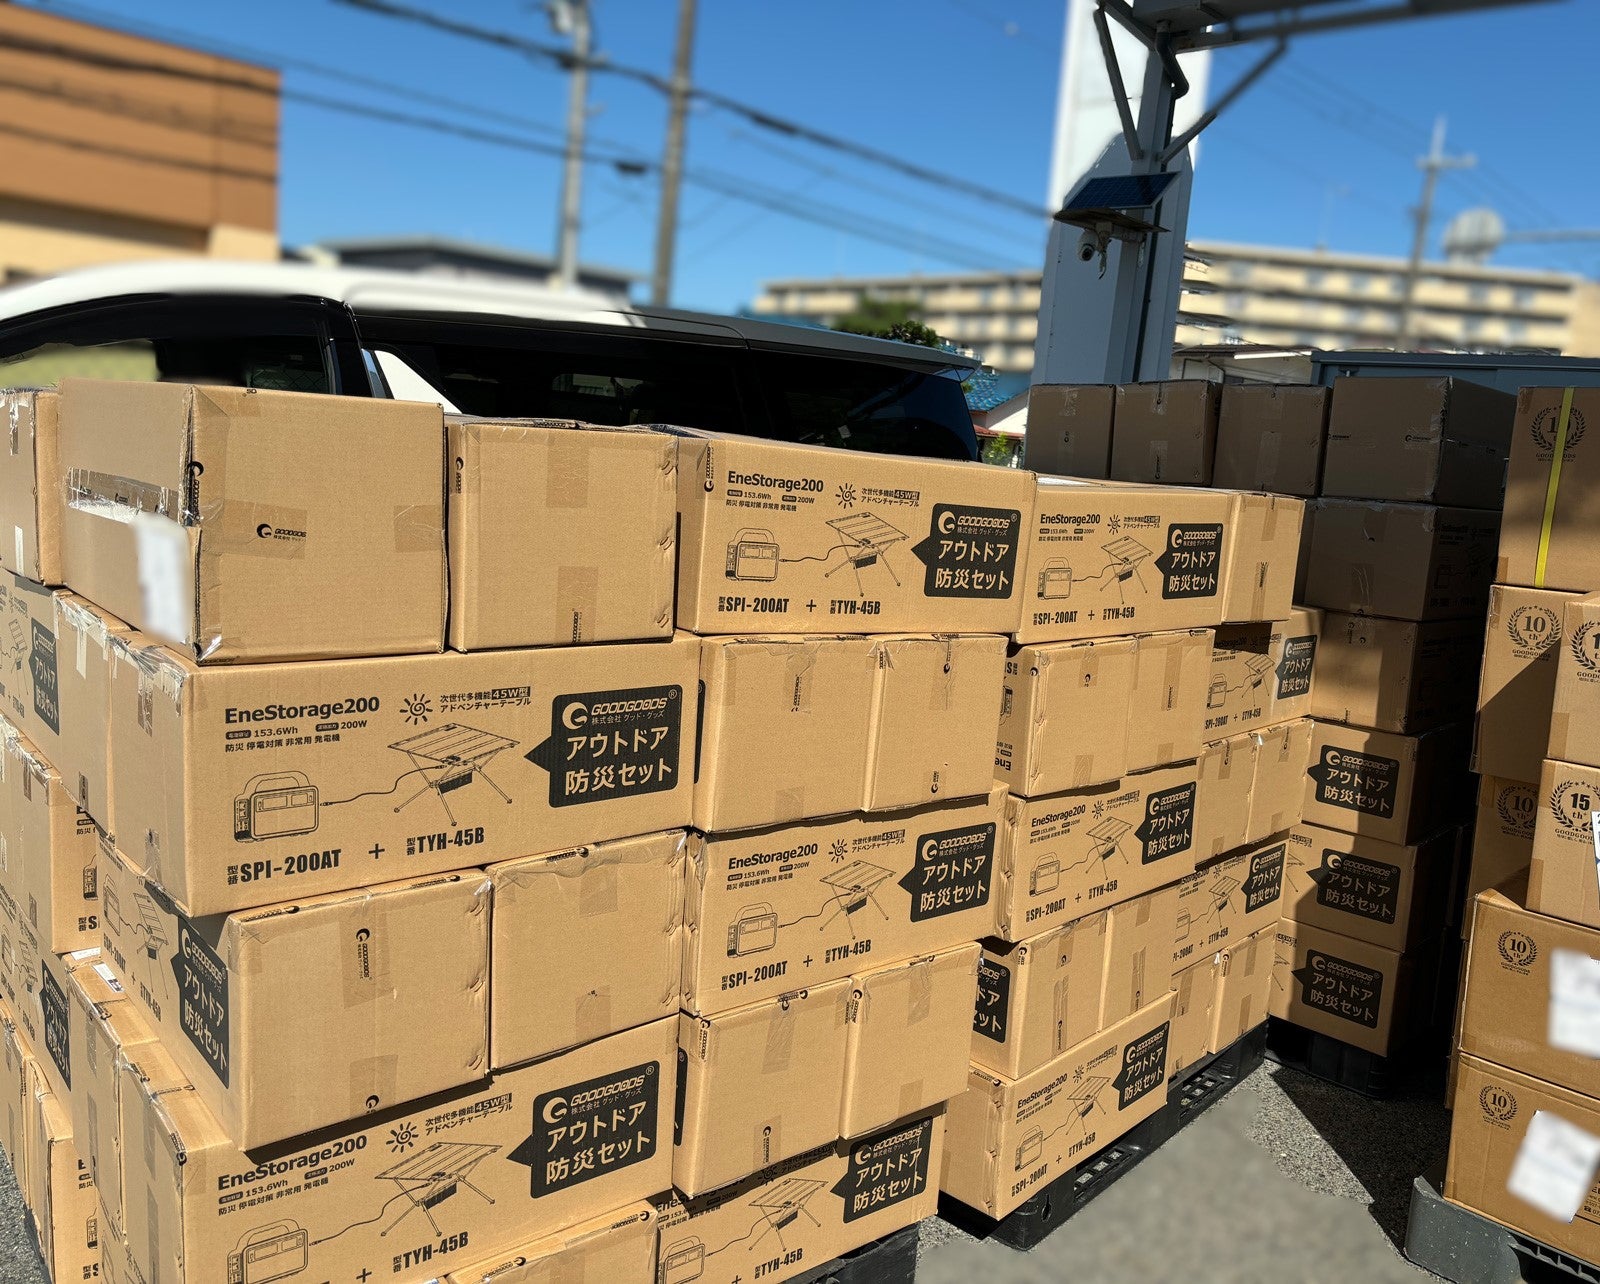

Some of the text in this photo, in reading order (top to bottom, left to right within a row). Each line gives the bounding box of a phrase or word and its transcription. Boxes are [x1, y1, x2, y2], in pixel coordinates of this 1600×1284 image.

[728, 470, 824, 492] EneStorage200
[743, 491, 772, 500] 153.6Wh
[797, 496, 815, 504] 200W
[957, 515, 1010, 529] GOODGOODS
[1040, 513, 1100, 525] EneStorage200
[1184, 531, 1217, 540] GOODGOODS
[938, 540, 1009, 563] アウトドア
[1171, 551, 1216, 569] アウトドア
[935, 567, 1009, 590] 防災セット
[1168, 575, 1215, 592] 防災セット
[726, 596, 789, 613] SPI-200AT
[837, 600, 880, 615] TYH-45B
[1038, 610, 1078, 625] SPI-200AT
[1107, 606, 1135, 619] TYH-45B
[1522, 615, 1546, 633] 10
[1529, 631, 1539, 641] th
[1284, 657, 1311, 674] アウトドア
[440, 686, 531, 703] 次世代多機能45W型
[1281, 676, 1309, 694] 防災セット
[225, 696, 380, 723] EneStorage200
[440, 698, 531, 713] アドベンチャーテーブル
[591, 697, 668, 716] GOODGOODS
[591, 711, 664, 725] 株式会社 グッド・グッズ
[254, 726, 298, 737] 153.6Wh
[341, 720, 367, 729] 200W
[225, 734, 340, 752] 防災 停電対策 非常用 発電機
[566, 726, 669, 761] アウトドア
[1341, 755, 1389, 771] GOODGOODS
[565, 757, 672, 796] 防災セット
[1326, 768, 1389, 792] アウトドア
[1324, 785, 1390, 812] 防災セット
[1512, 795, 1533, 813] 10
[1571, 793, 1590, 811] 15
[1031, 804, 1086, 828] EneStorage200
[1149, 808, 1190, 835] アウトドア
[1572, 811, 1583, 819] th
[938, 832, 987, 849] GOODGOODS
[1148, 831, 1190, 856] 防災セット
[227, 865, 239, 885] 型番
[240, 849, 342, 883] SPI-200AT
[417, 827, 485, 853] TYH-45B
[728, 843, 818, 870] EneStorage200
[743, 869, 770, 879] 153.6Wh
[793, 861, 810, 870] 200W
[922, 855, 987, 886] アウトドア
[1252, 864, 1280, 890] アウトドア
[1249, 885, 1280, 908] 防災セット
[1328, 872, 1391, 897] アウトドア
[920, 883, 987, 913] 防災セット
[1030, 898, 1066, 921] SPI-200AT
[1092, 879, 1118, 899] TYH-45B
[1325, 888, 1391, 917] 防災セット
[1510, 938, 1527, 953] 10
[728, 960, 787, 989] SPI-200AT
[831, 939, 872, 962] TYH-45B
[184, 964, 225, 1027] アウトドア
[1311, 972, 1373, 1000] アウトドア
[1310, 989, 1374, 1021] 防災セット
[184, 998, 227, 1071] 防災セット
[1125, 1046, 1163, 1081] アウトドア
[570, 1074, 645, 1107] GOODGOODS
[1017, 1073, 1068, 1109] EneStorage200
[1123, 1067, 1163, 1102] 防災セット
[425, 1093, 512, 1126] 次世代多機能45W型
[571, 1088, 642, 1115] 株式会社 グッド・グッズ
[1491, 1093, 1507, 1108] 10
[425, 1104, 513, 1135] アドベンチャーテーブル
[547, 1101, 647, 1152] アウトドア
[873, 1126, 923, 1149] GOODGOODS
[218, 1135, 367, 1191] EneStorage200
[545, 1131, 650, 1185] 防災セット
[856, 1149, 923, 1187] アウトドア
[245, 1158, 355, 1197] 153.6Wh 200W
[1015, 1163, 1048, 1197] SPI-200AT
[218, 1205, 237, 1216] 防災
[276, 1186, 301, 1200] 非常用
[853, 1171, 923, 1213] 防災セット
[402, 1231, 469, 1269] TYH-45B
[760, 1248, 803, 1276] TYH-45B
